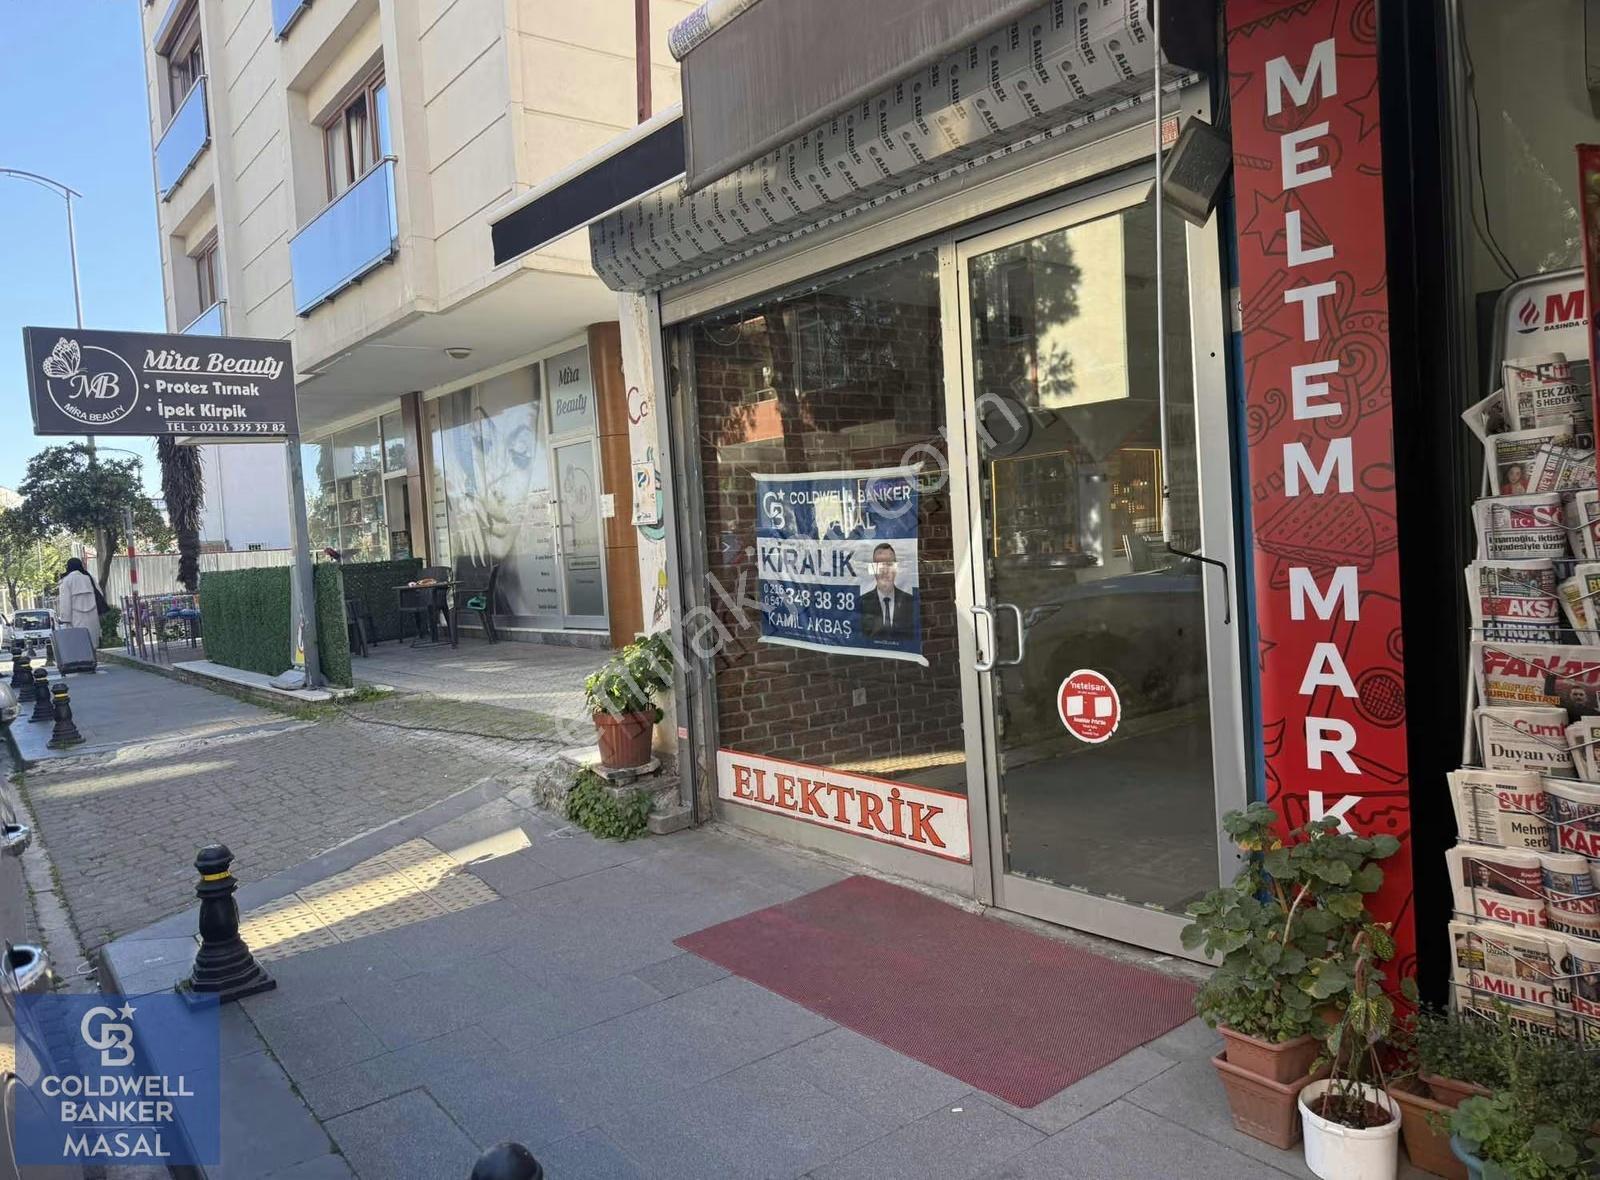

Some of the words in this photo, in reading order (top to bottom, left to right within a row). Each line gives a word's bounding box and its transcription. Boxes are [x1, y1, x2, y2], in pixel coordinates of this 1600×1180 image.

[1114, 52, 1136, 81] ALUS
[1068, 73, 1089, 101] ALUS
[1024, 92, 1042, 117] ALUS
[1265, 37, 1354, 498] MELTEM
[1545, 290, 1585, 324] M
[143, 349, 200, 370] Mira
[207, 353, 283, 380] Beauty
[558, 366, 579, 387] Mira
[156, 379, 208, 394] Protez
[212, 381, 259, 396] Tırnak
[64, 403, 87, 420] MİRA
[89, 404, 126, 421] BEAUTY
[158, 398, 196, 418] İpek
[200, 403, 247, 419] Kirpik
[556, 394, 587, 417] Beauty
[166, 422, 188, 431] TEL
[200, 423, 229, 432] 0216
[254, 423, 268, 432] 39
[272, 423, 286, 432] 82
[858, 485, 911, 503] BANKER
[761, 541, 857, 578] KİRALIK
[785, 587, 811, 608] 348
[815, 591, 832, 609] 38
[836, 592, 855, 611] 38
[768, 611, 803, 630] KAMİL
[807, 618, 852, 639] AKBAŞ
[1484, 651, 1600, 684] FANAT
[1288, 566, 1363, 840] MARK
[1491, 743, 1544, 764] Duyan
[731, 763, 946, 848] ELEKTRİK
[1499, 791, 1547, 812] evre
[1511, 821, 1549, 836] Mehm
[1524, 836, 1550, 848] serb
[1479, 897, 1535, 928] Yeni
